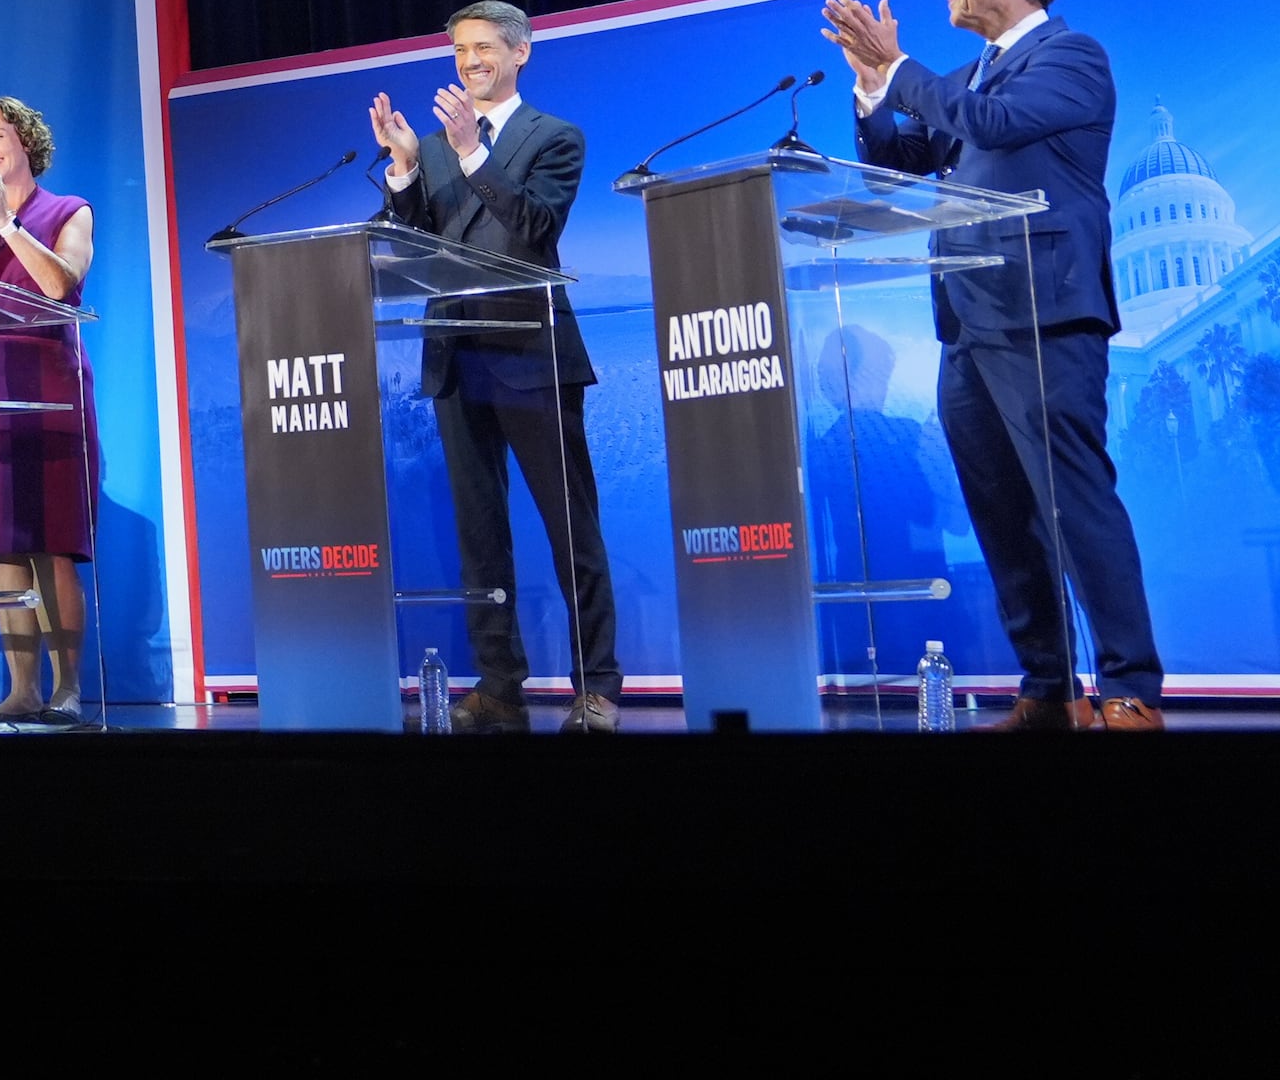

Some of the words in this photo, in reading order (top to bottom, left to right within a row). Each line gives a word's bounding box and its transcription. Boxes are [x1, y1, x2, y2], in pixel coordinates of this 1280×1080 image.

[669, 302, 772, 361] ANTONIO
[267, 353, 344, 399] MATT
[664, 355, 784, 401] VILLARAIGOSA
[271, 401, 348, 433] MAHAN
[261, 546, 321, 571] VOTERS
[322, 544, 379, 569] DECIDE
[683, 525, 739, 555] VOTERS
[740, 523, 794, 552] DECIDE
